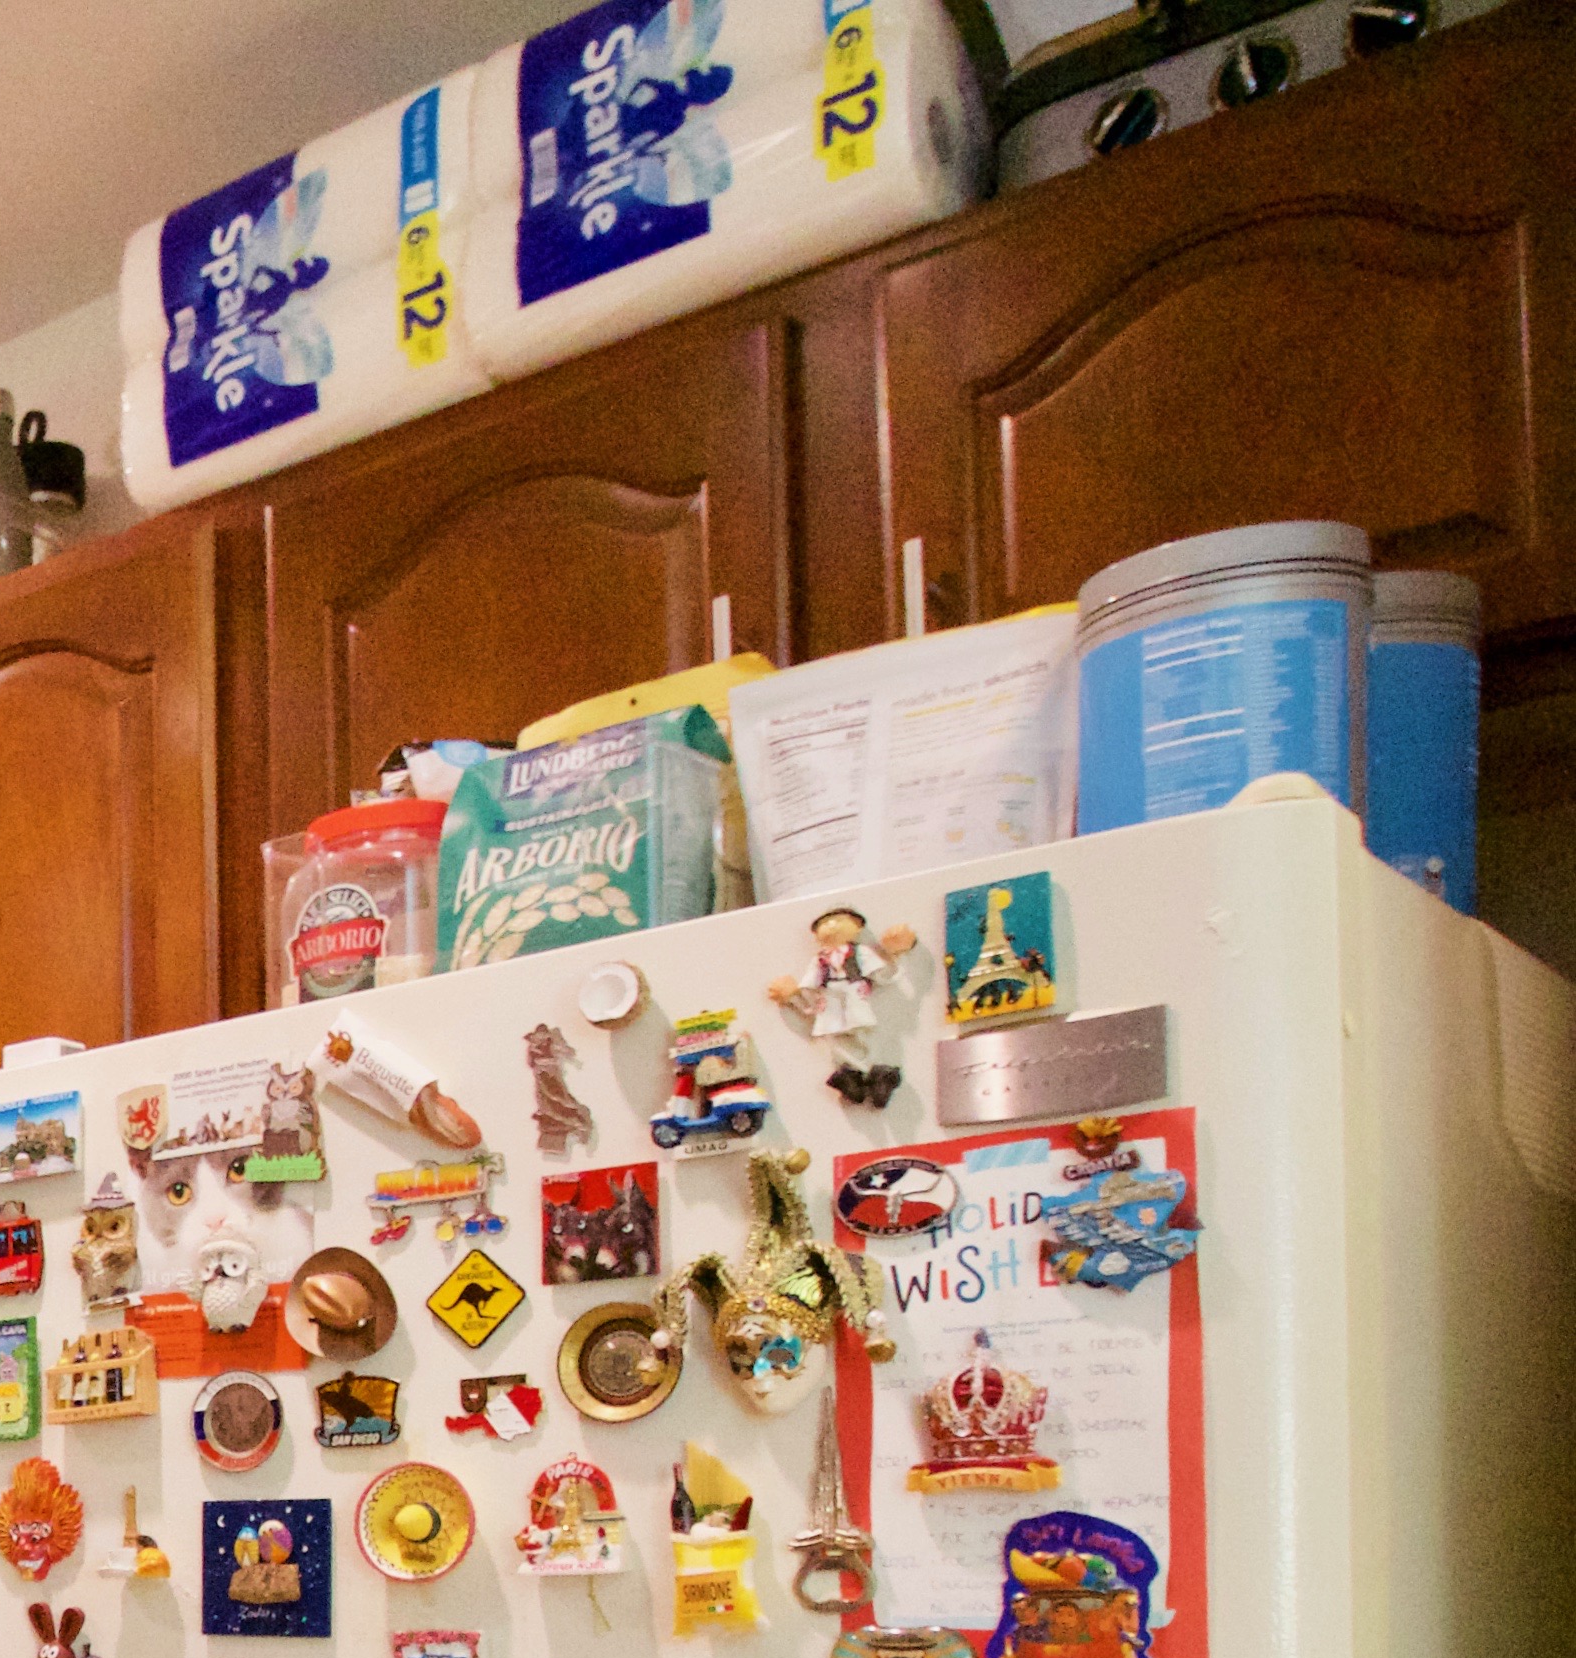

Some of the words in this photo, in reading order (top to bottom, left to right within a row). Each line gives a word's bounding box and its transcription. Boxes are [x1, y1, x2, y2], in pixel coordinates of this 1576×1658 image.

[836, 27, 862, 50] 6
[823, 71, 878, 147] 12
[567, 24, 636, 241] Sparkle
[406, 226, 430, 246] 6
[199, 213, 255, 412] Sparkle
[403, 272, 447, 341] 12
[452, 815, 639, 916] ARBORIO
[297, 925, 382, 961] ARBORIO
[355, 1047, 415, 1096] Baguette
[331, 1434, 352, 1447] SAN
[546, 1461, 595, 1482] PARIS
[936, 1472, 1014, 1489] VIENNA
